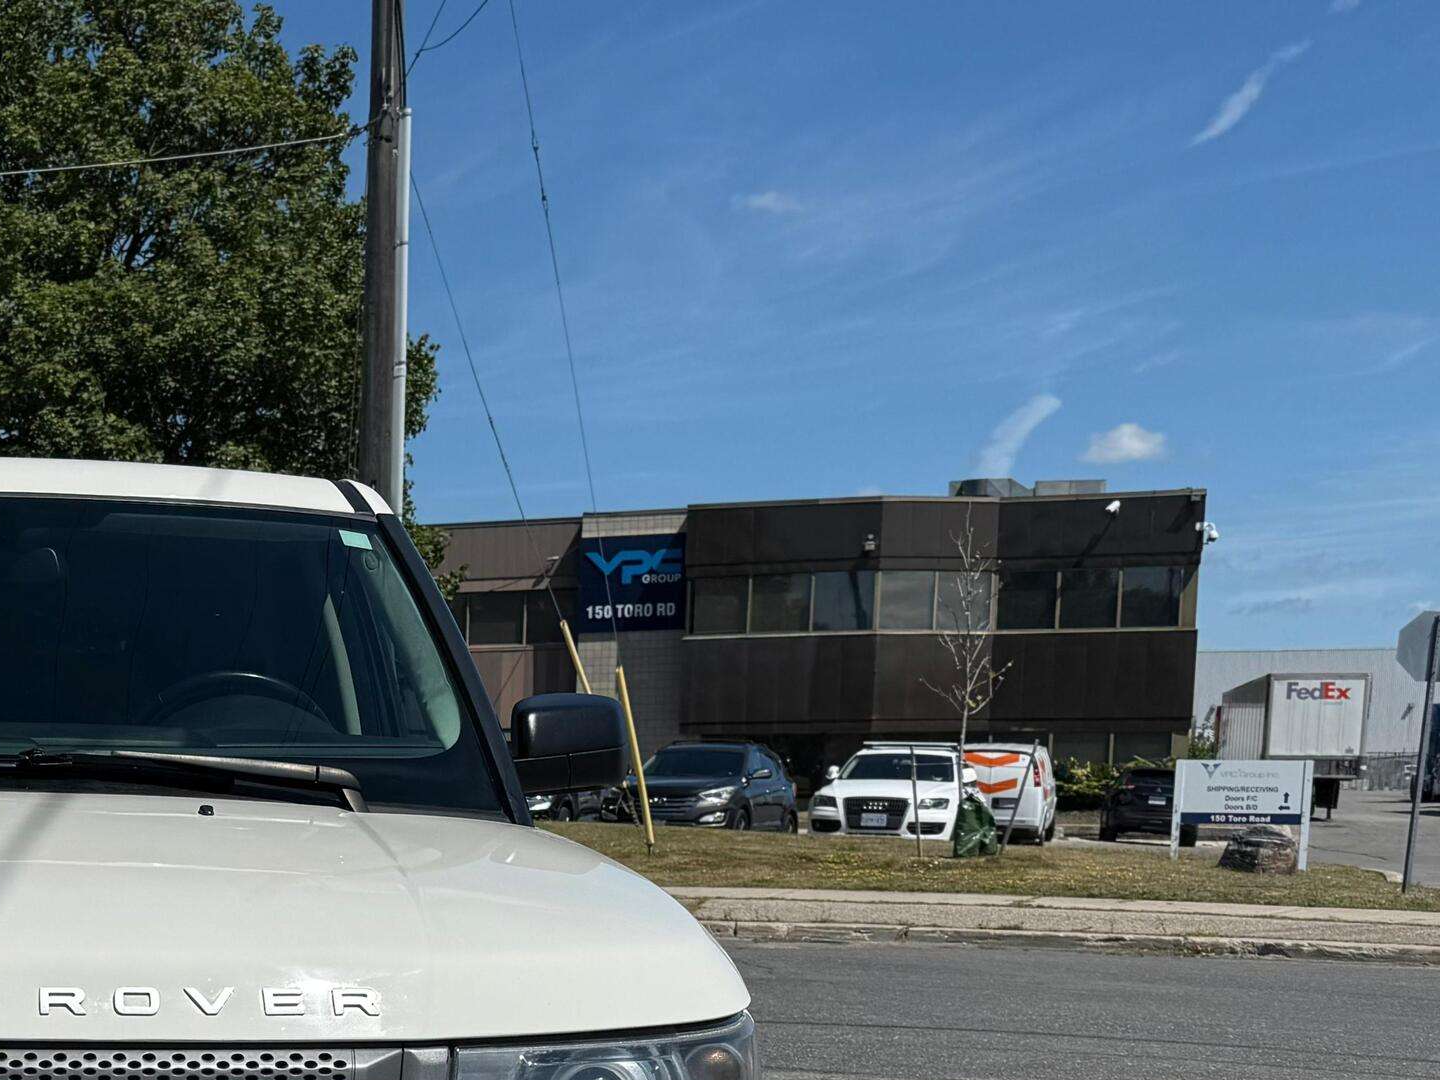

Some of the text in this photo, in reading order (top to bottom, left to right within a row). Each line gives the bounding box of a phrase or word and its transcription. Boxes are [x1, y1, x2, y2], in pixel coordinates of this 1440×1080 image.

[642, 573, 682, 584] GROUP
[586, 602, 676, 619] 150 TORO RD
[1286, 682, 1351, 700] FedEx
[1249, 815, 1271, 823] Road
[38, 986, 381, 1017] ROVER
